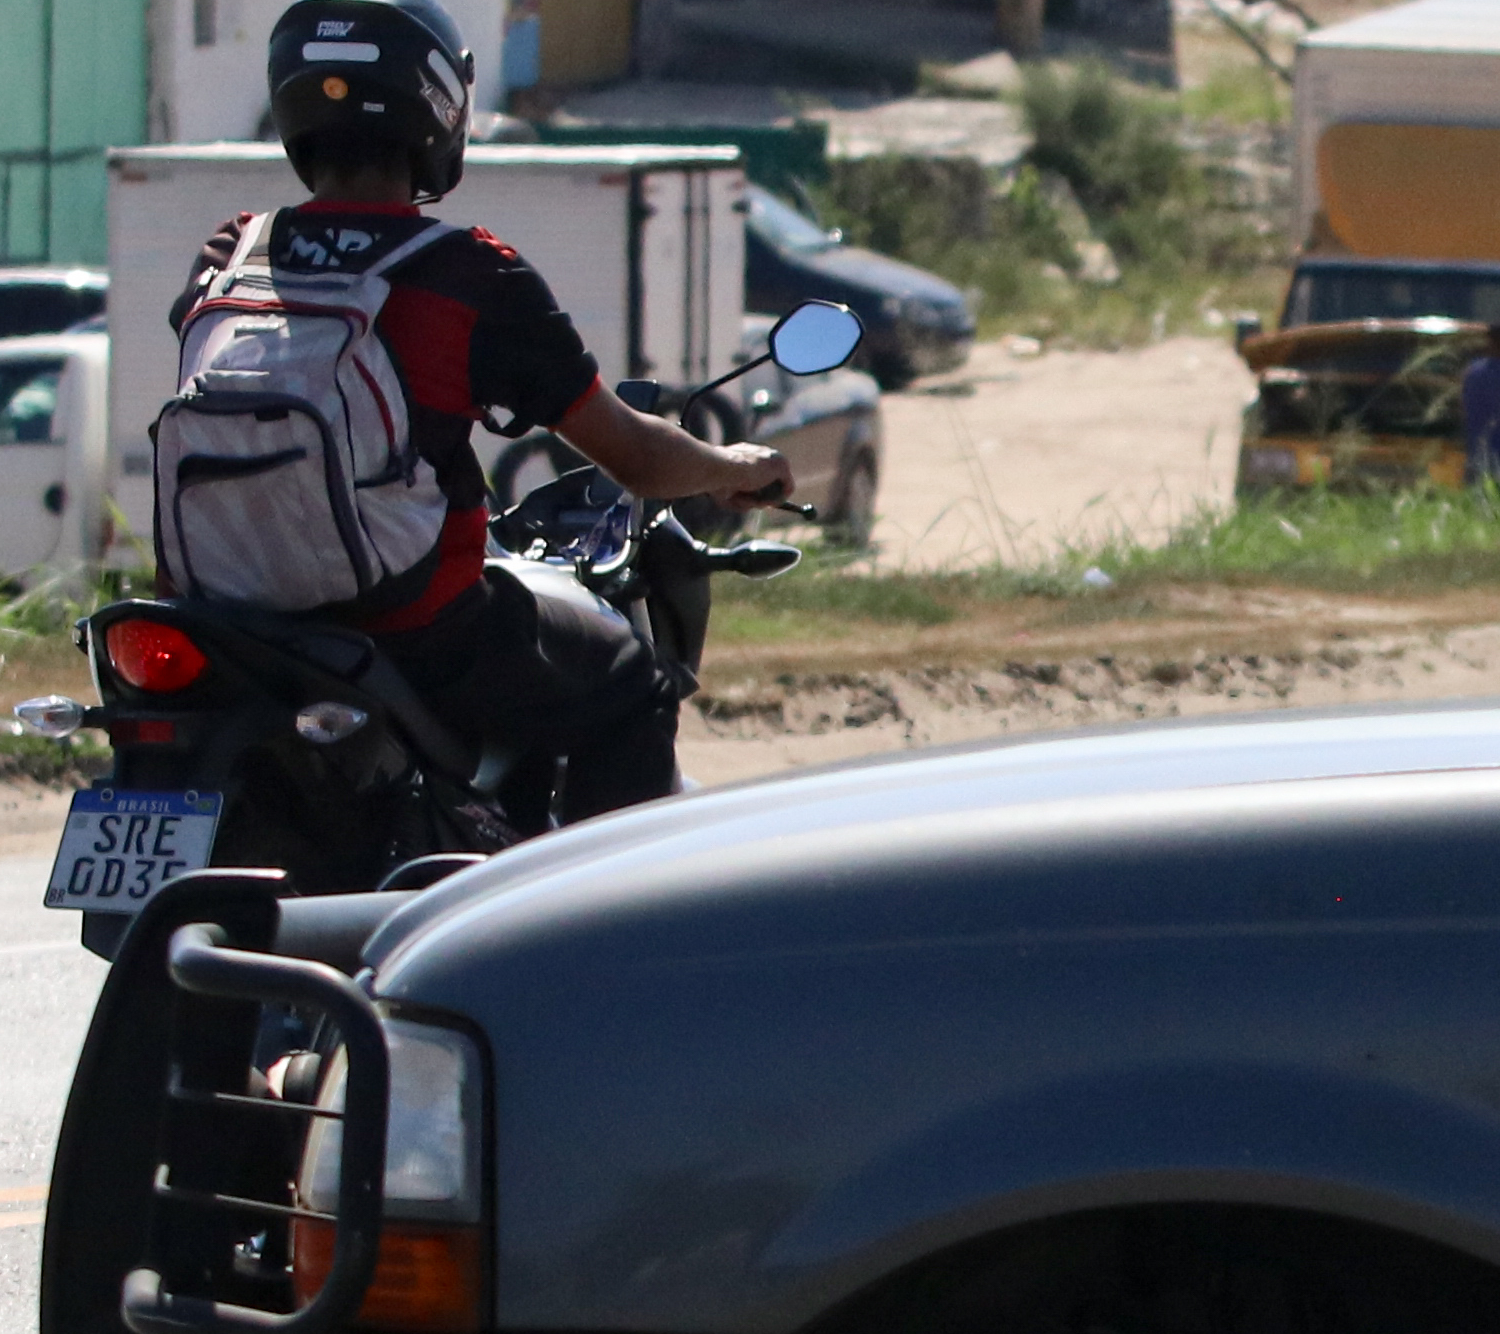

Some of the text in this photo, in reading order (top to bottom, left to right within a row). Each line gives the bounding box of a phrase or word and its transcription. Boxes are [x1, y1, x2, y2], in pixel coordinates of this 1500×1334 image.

[117, 799, 172, 813] BRASIL
[93, 814, 182, 857] SRE
[48, 888, 66, 904] BR
